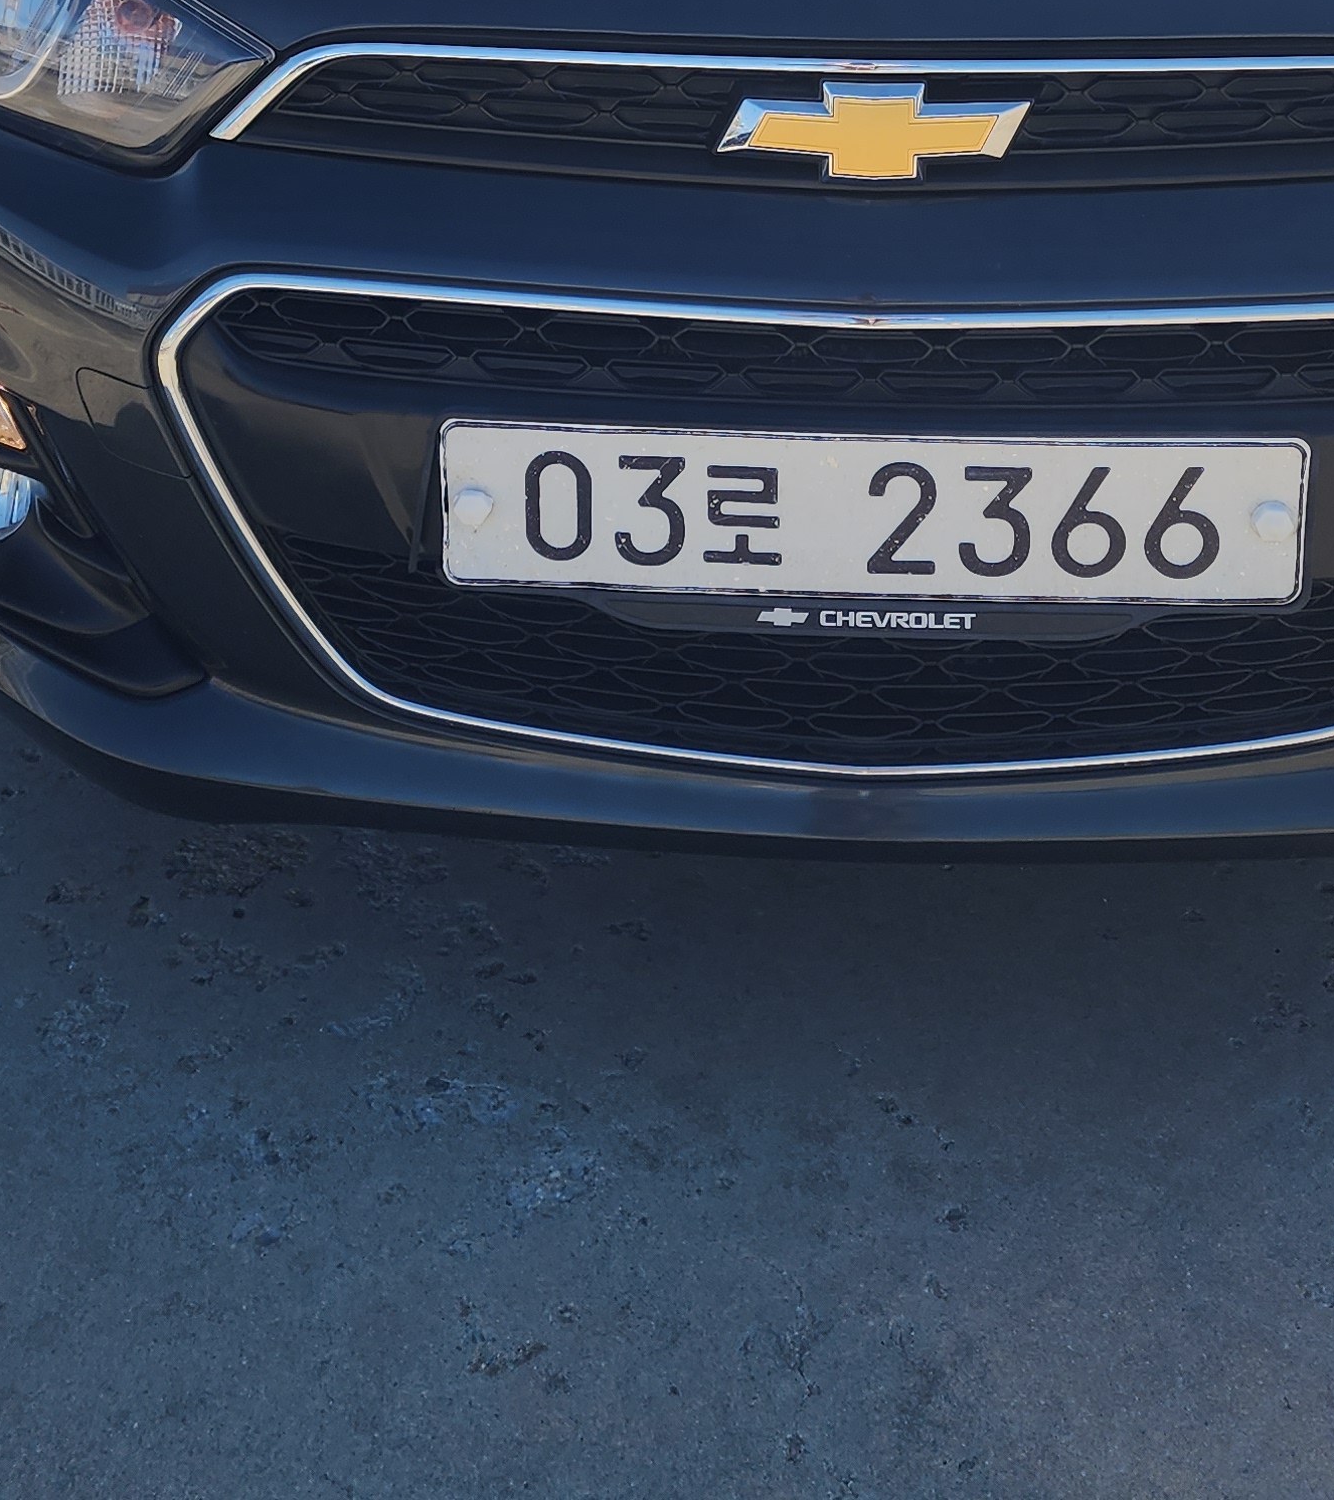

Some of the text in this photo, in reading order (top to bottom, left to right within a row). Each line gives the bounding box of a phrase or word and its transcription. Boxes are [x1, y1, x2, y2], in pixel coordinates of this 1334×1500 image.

[524, 450, 1220, 580] 03로 2366
[819, 610, 976, 630] CHEVROLET
